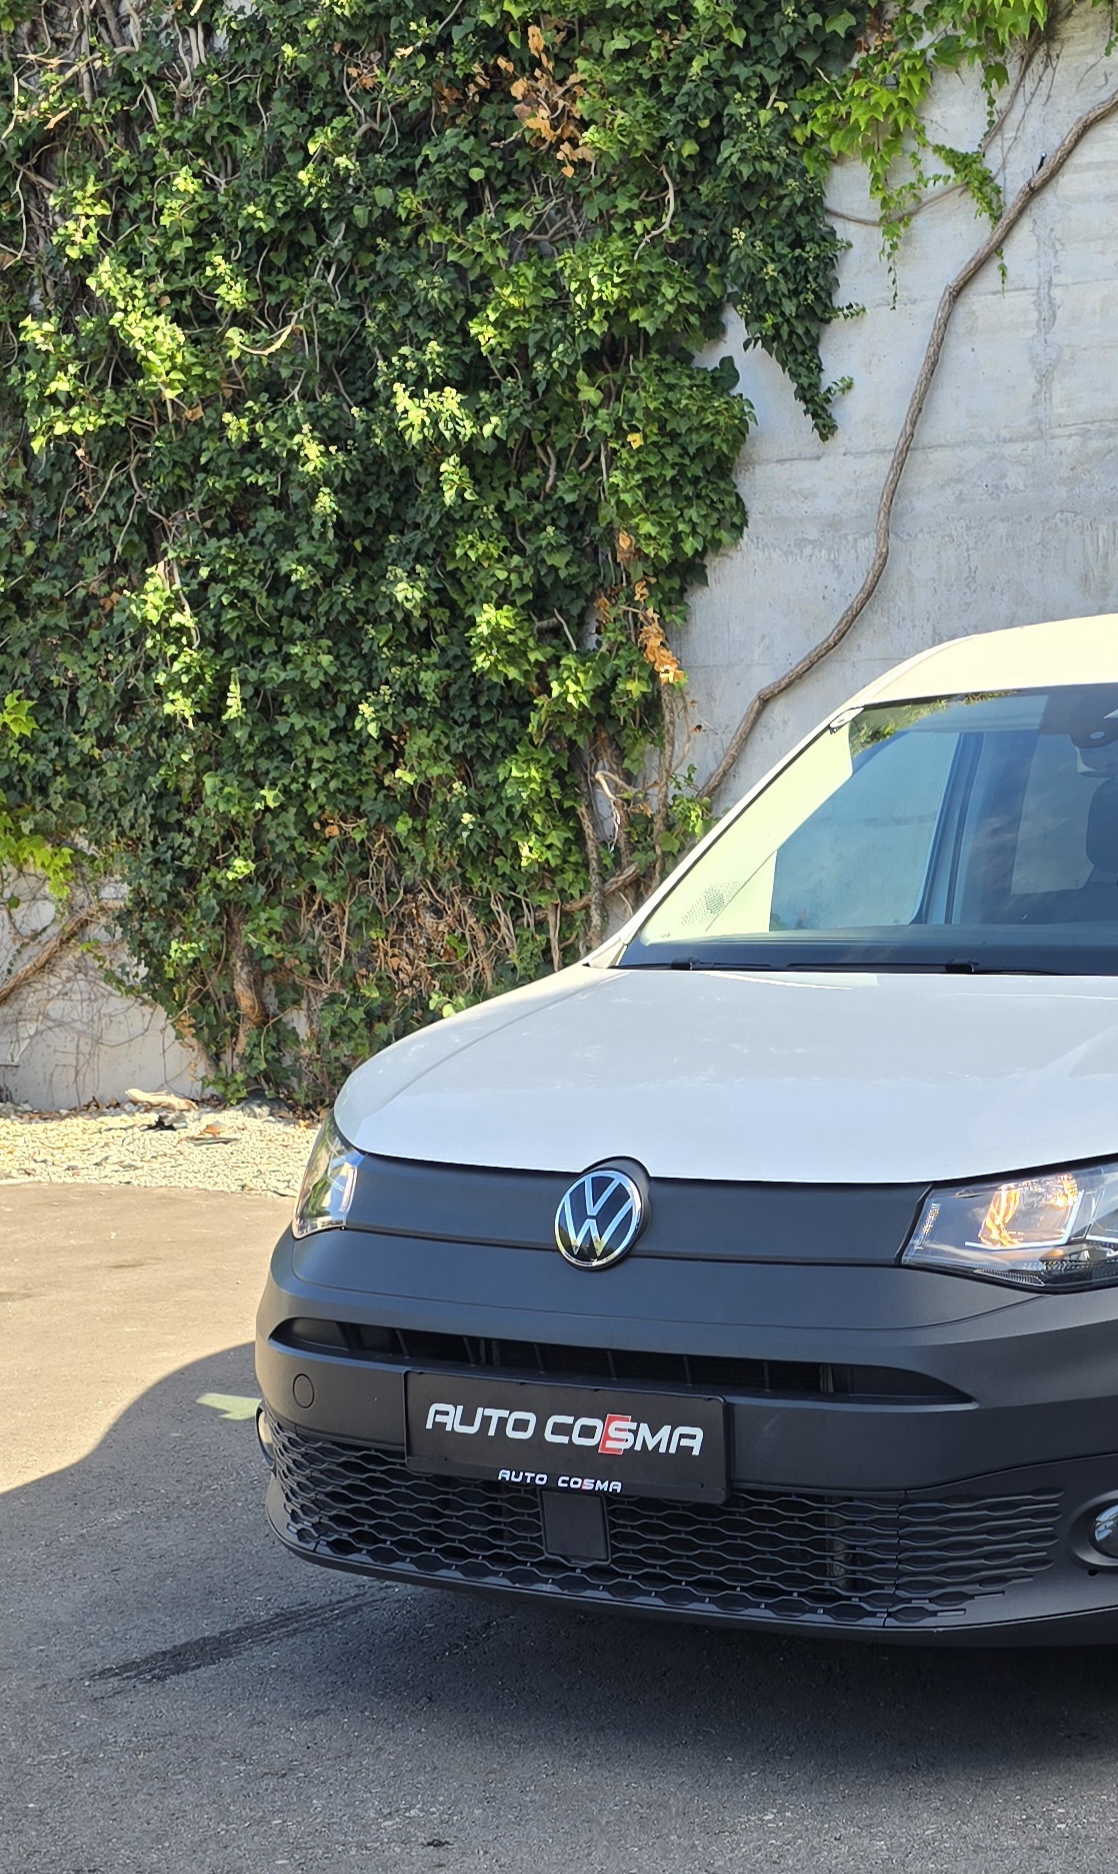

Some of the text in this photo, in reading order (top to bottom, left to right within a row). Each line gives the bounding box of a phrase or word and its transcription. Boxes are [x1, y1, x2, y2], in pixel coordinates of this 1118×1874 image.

[425, 1402, 704, 1456] AUTO COSMA
[498, 1469, 622, 1493] AUTO COSMA
